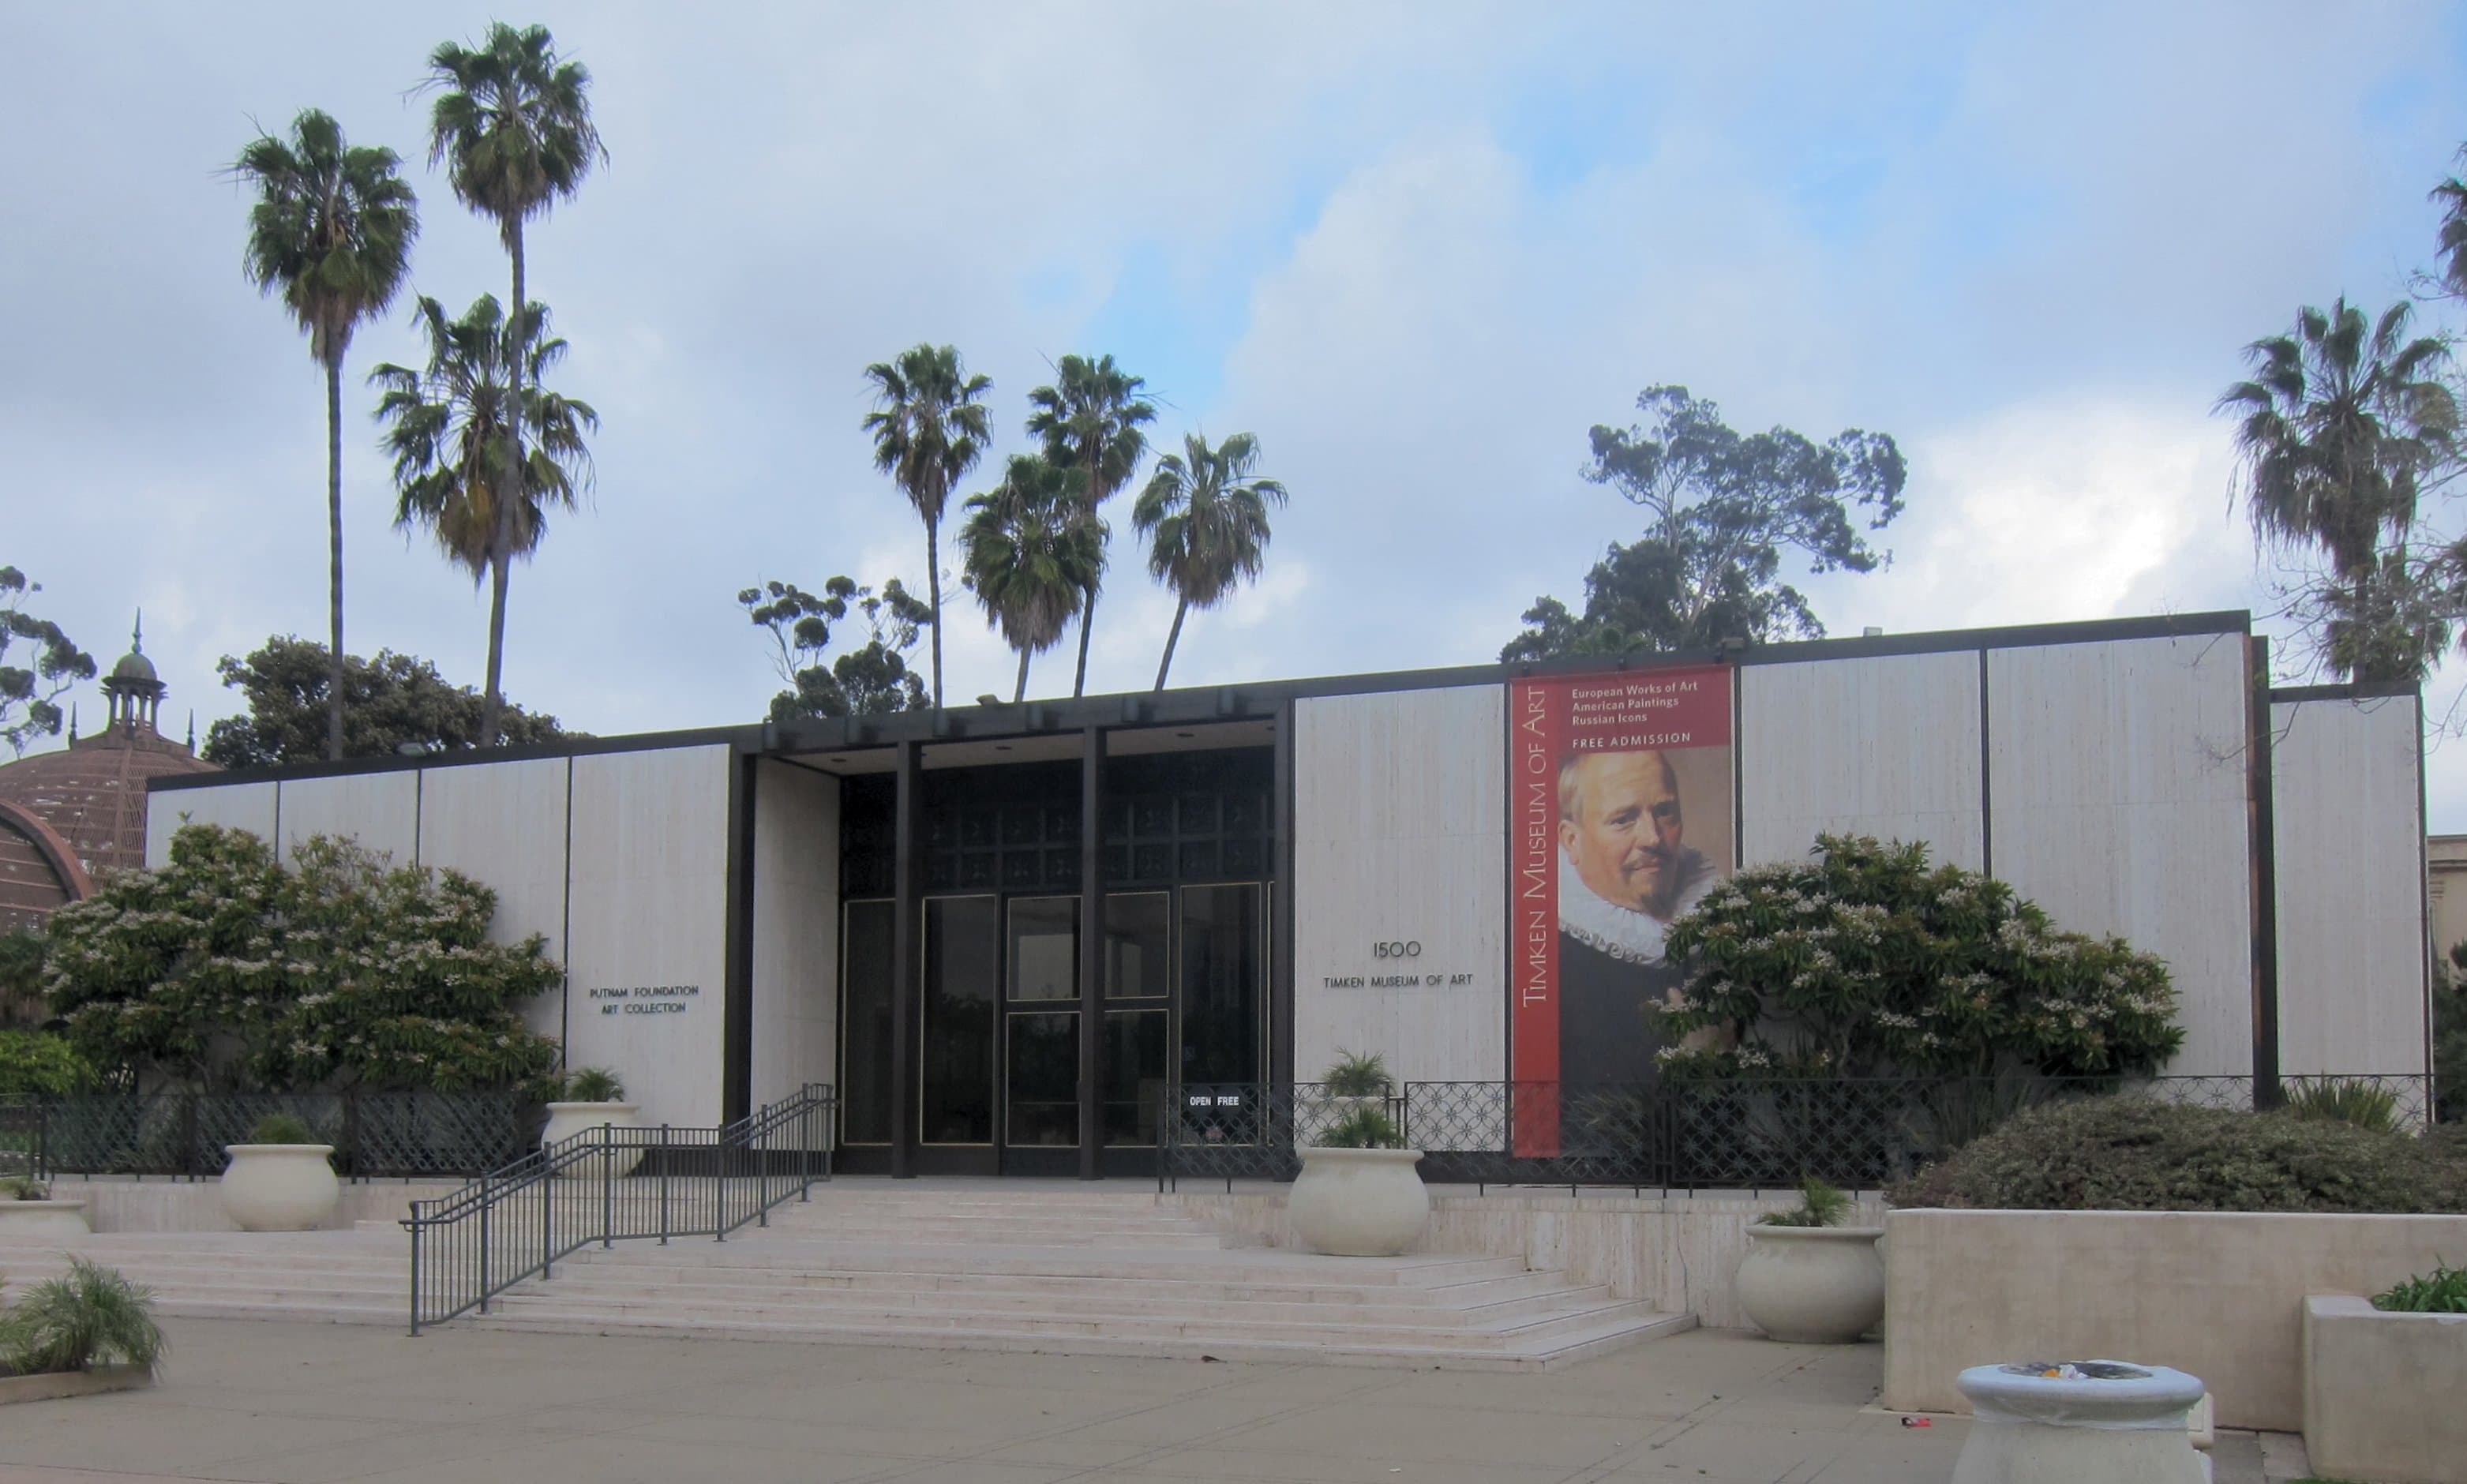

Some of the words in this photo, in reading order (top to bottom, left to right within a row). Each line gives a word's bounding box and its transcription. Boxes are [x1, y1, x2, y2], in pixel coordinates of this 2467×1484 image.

[1572, 688, 1623, 699] European
[1626, 684, 1662, 696] Works
[1665, 682, 1676, 693] of
[1679, 681, 1698, 692] Art
[1522, 686, 1546, 737] ART
[1573, 699, 1625, 712] American
[1628, 698, 1679, 710] Paintings
[1573, 714, 1614, 725] Russian
[1618, 713, 1648, 724] Icons
[1573, 737, 1604, 748] FREE
[1610, 733, 1691, 747] ADMISSION
[1528, 743, 1547, 774] OF
[1374, 940, 1421, 957] 1500
[1323, 976, 1364, 987] TIMKEN
[1370, 975, 1419, 987] MUSEUM
[1426, 974, 1443, 986] OF
[1450, 973, 1473, 985] ART
[590, 987, 628, 998] PUTNAM
[634, 985, 699, 997] FOUNDATION
[602, 1004, 618, 1014] ART
[625, 1002, 686, 1014] COLLECTION
[1190, 1096, 1211, 1105] OPEN
[1217, 1096, 1239, 1105] FREE
